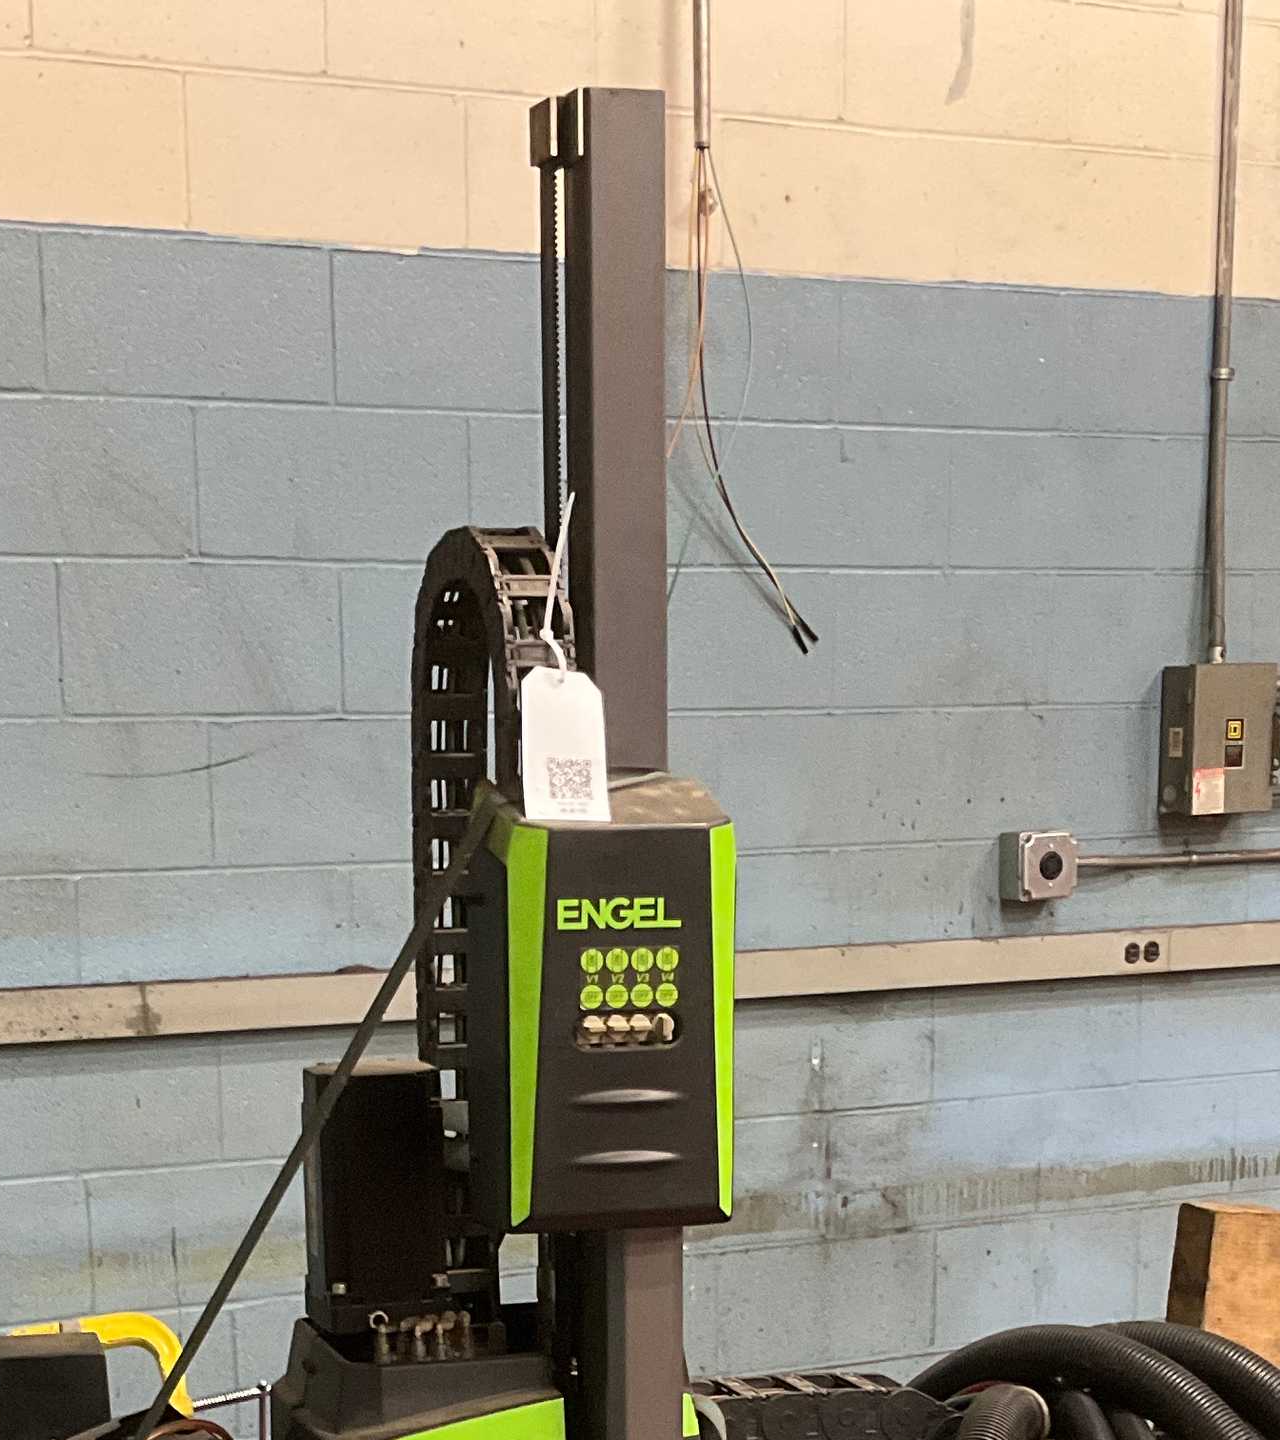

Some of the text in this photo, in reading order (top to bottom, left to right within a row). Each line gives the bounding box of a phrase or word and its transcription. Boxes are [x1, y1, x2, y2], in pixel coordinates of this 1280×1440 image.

[557, 897, 682, 931] ENGEL
[611, 973, 625, 983] V2
[636, 973, 650, 982] V3
